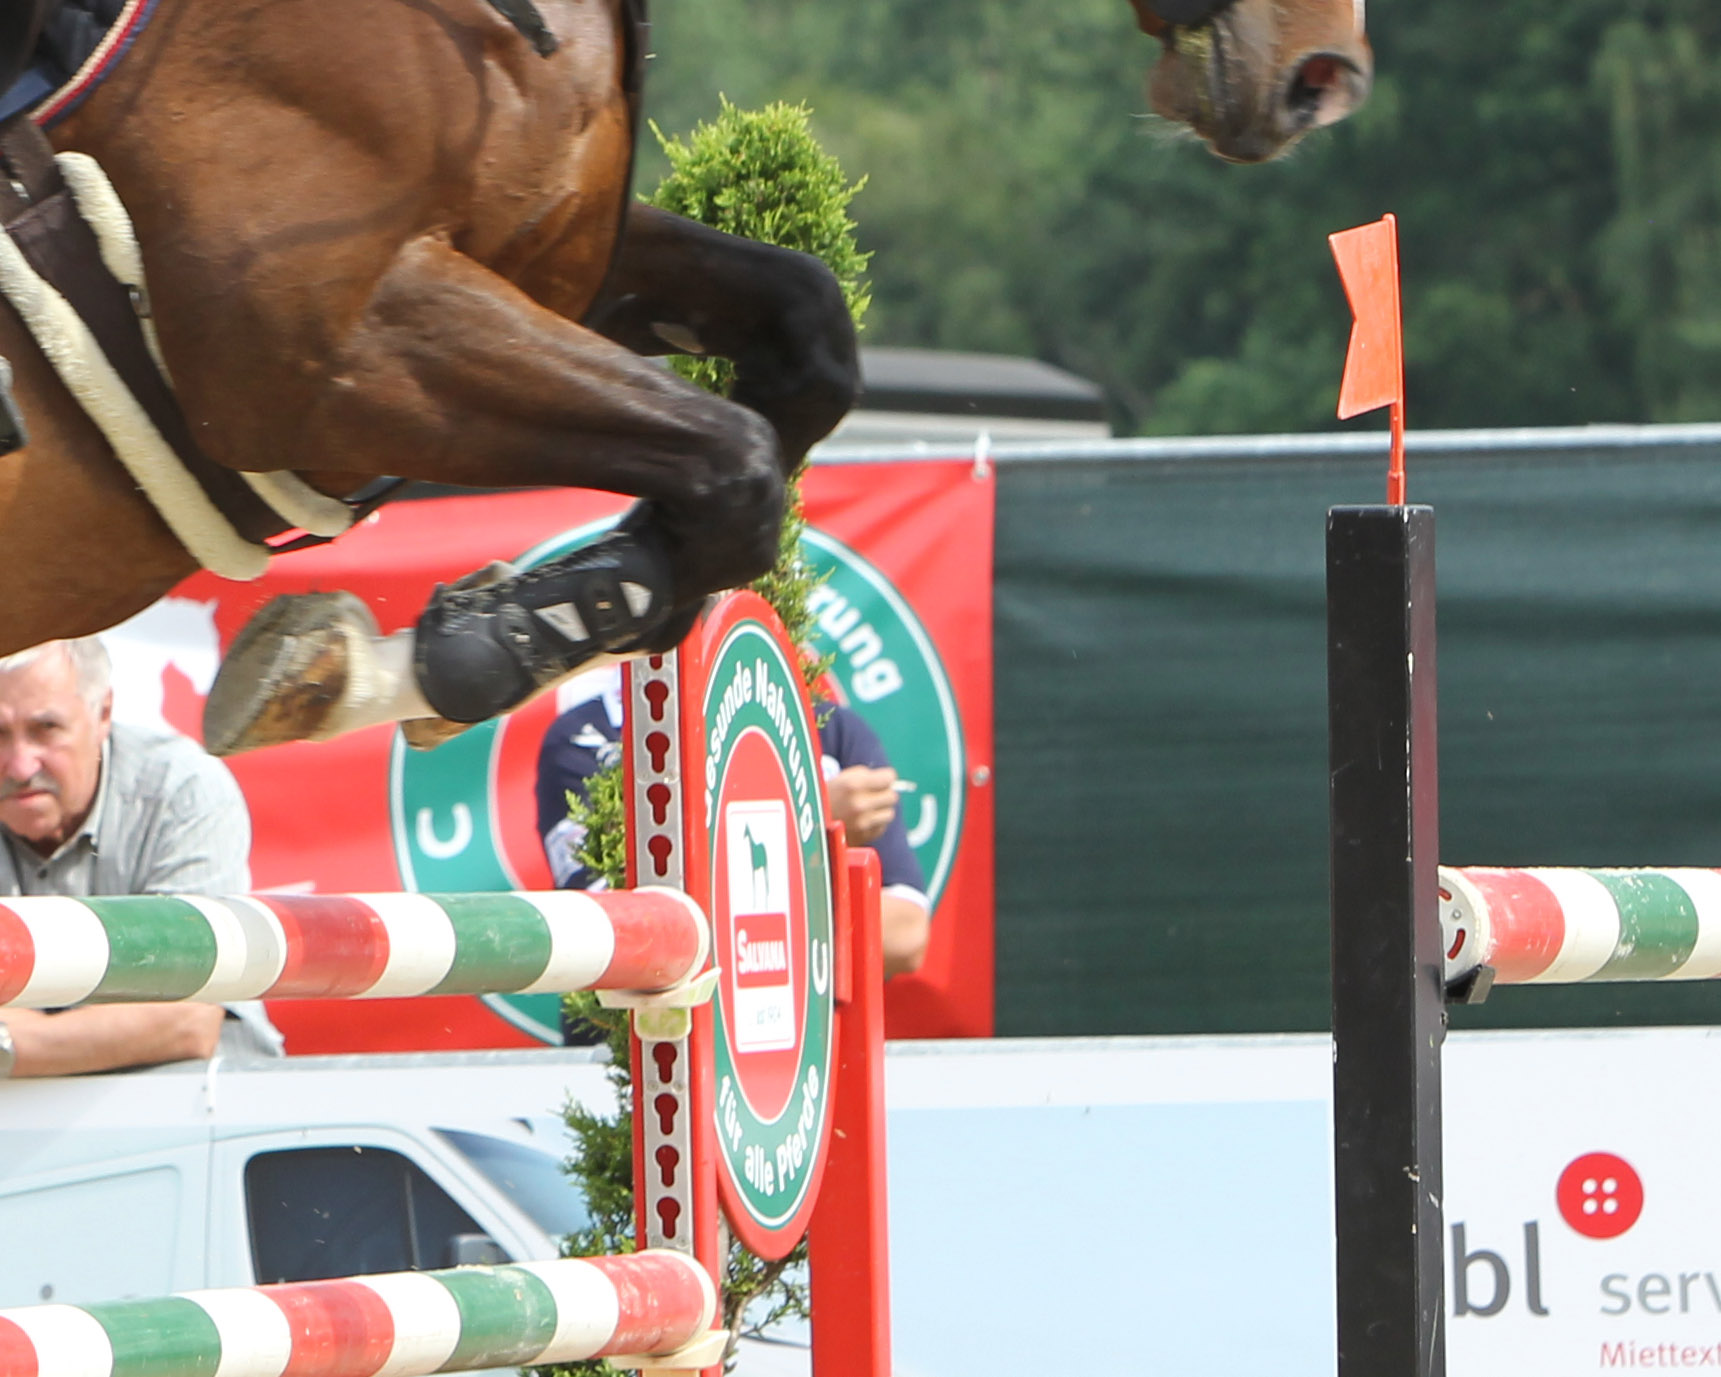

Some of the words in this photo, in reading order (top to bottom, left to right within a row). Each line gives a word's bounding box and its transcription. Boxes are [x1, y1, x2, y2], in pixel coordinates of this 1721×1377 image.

[755, 657, 814, 843] Nahrung
[719, 1075, 743, 1153] für
[744, 1144, 774, 1197] alle
[776, 1064, 819, 1192] Pferde
